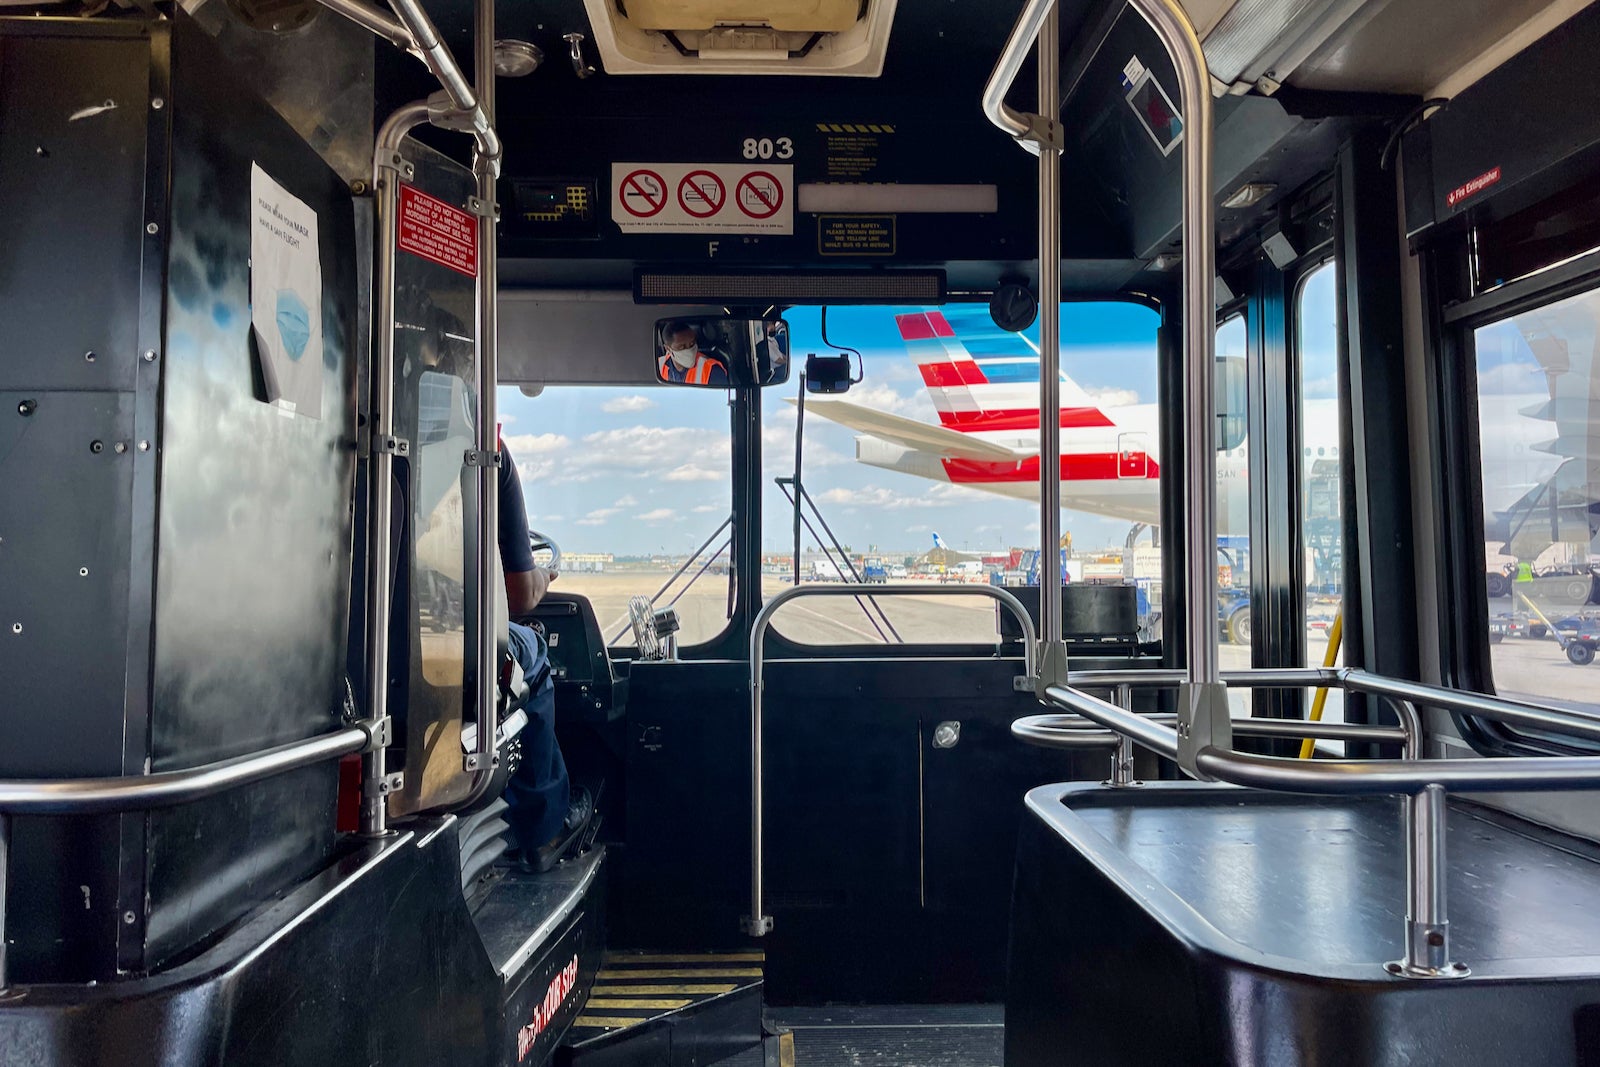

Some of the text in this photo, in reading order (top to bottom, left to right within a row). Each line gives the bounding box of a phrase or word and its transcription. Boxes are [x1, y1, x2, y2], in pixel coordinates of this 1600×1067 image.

[742, 137, 794, 159] 803
[1456, 171, 1497, 199] Fire Extinguisher
[406, 208, 430, 224] MOTORIST
[432, 220, 450, 233] CANNOT
[452, 229, 461, 238] SEE
[407, 200, 412, 208] IN
[414, 203, 430, 215] FRONT
[444, 217, 460, 229] METRO
[414, 195, 465, 224] PLEASE DO NOT WALK
[283, 232, 300, 249] FLIGHT
[294, 221, 309, 237] MASK
[404, 222, 416, 230] FAVOR
[431, 233, 448, 244] CAMINAR
[450, 241, 467, 253] ENFRENTE
[708, 241, 719, 257] F
[543, 974, 561, 1025] YOUR
[563, 953, 578, 1000] STEP
